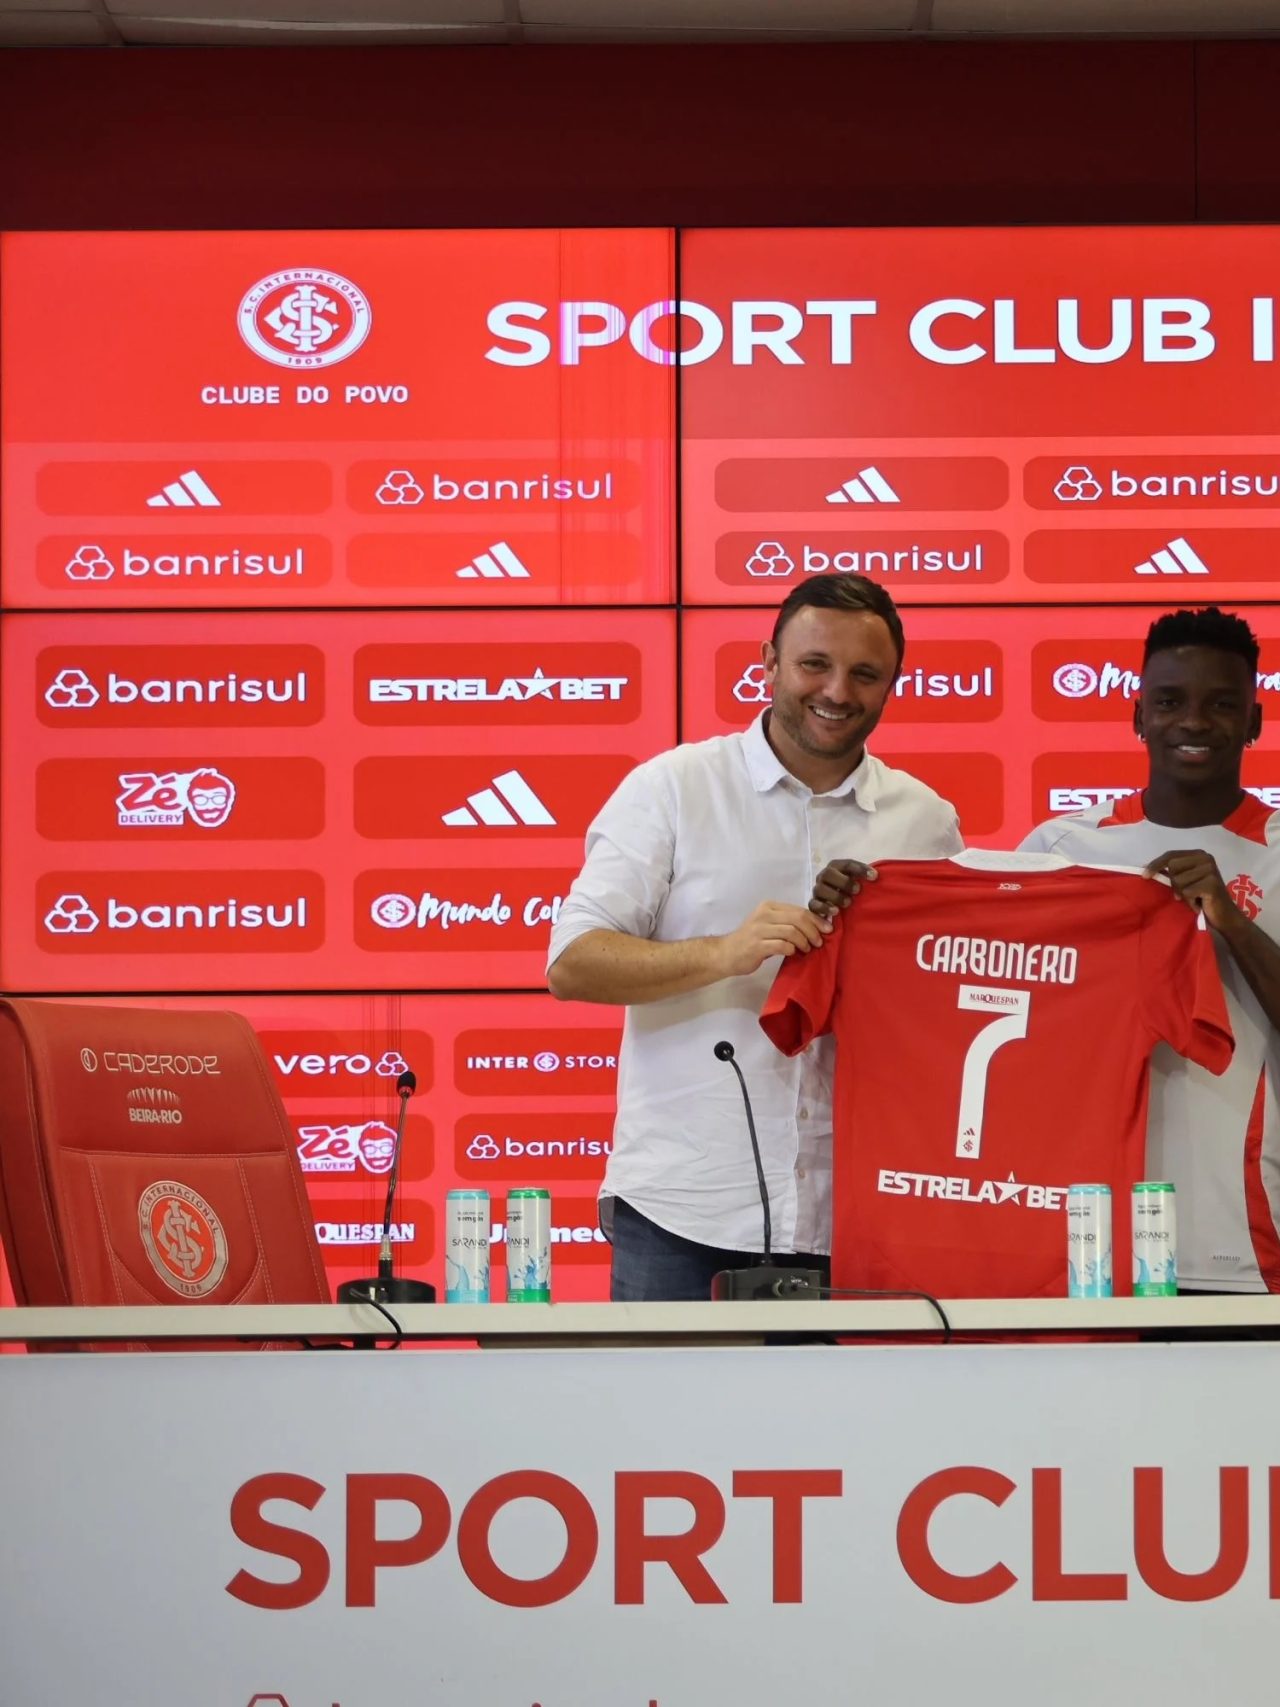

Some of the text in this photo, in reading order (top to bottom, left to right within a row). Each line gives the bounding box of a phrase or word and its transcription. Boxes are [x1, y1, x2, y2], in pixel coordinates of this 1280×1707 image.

[485, 301, 876, 366] SPORT
[910, 299, 1215, 364] CLUB
[202, 386, 408, 404] CLUBE DO POVO
[433, 473, 611, 500] banrisul
[124, 549, 303, 576] banrisul
[803, 544, 982, 572] banrisul
[108, 672, 305, 703] banrisul
[118, 774, 184, 812] Zé
[120, 814, 183, 824] DELIVERY
[108, 897, 306, 928] banrisul
[416, 893, 511, 930] Mundo
[916, 934, 1078, 984] CARBONERO
[103, 1052, 221, 1075] CADERODE
[273, 1054, 371, 1075] vero
[467, 1056, 617, 1069] INTER STOR
[955, 984, 1031, 1159] 7
[314, 1222, 416, 1245] QUESPAN
[226, 1469, 843, 1610] SPORT
